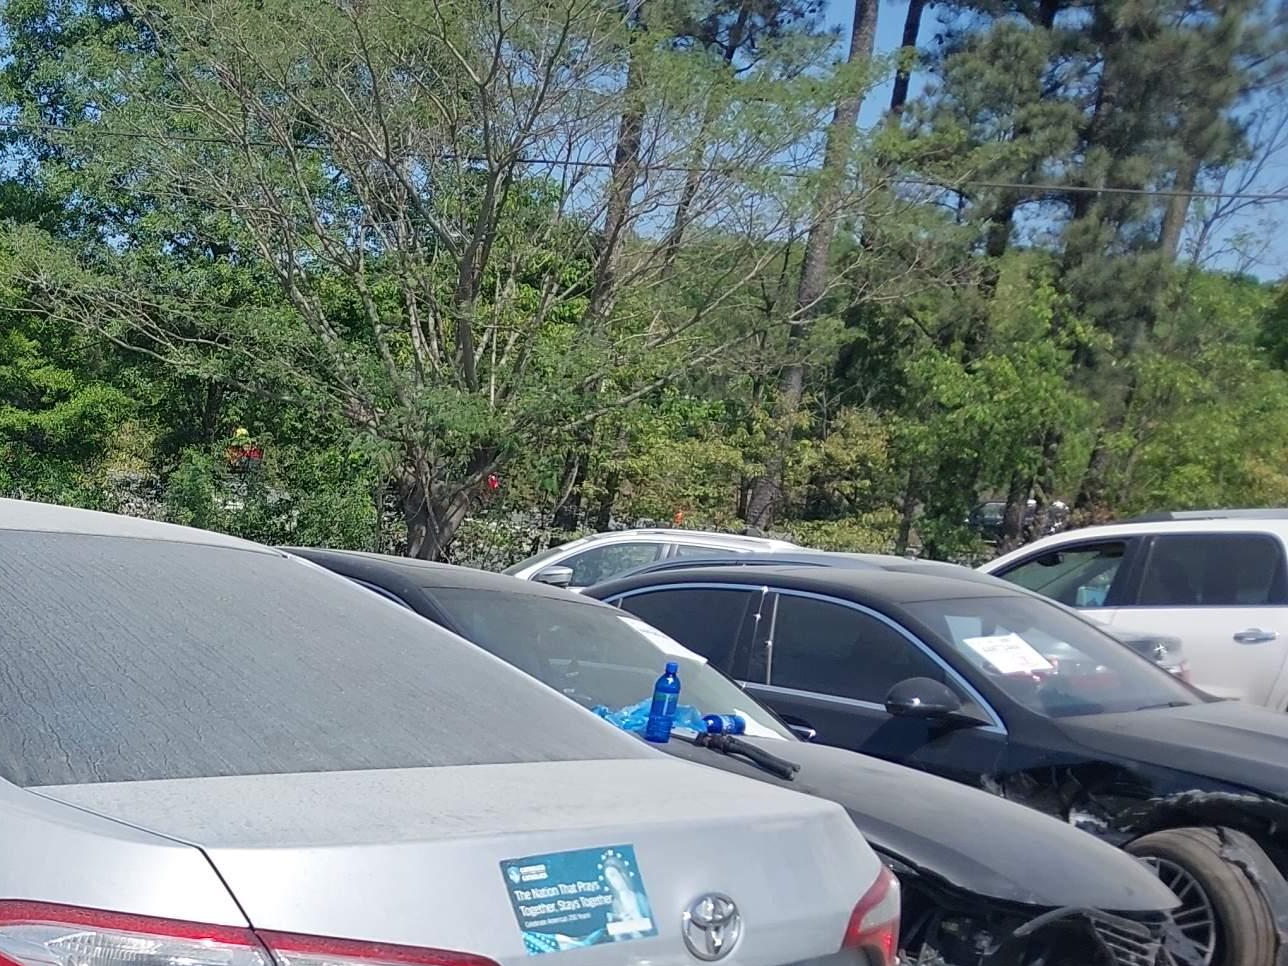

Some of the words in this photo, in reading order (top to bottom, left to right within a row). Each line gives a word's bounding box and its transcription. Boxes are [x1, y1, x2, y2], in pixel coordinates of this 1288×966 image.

[514, 890, 532, 901] The
[531, 886, 560, 898] Nation
[558, 883, 577, 895] That
[577, 881, 600, 892] Prays
[557, 899, 580, 911] Stays
[579, 894, 613, 908] Together
